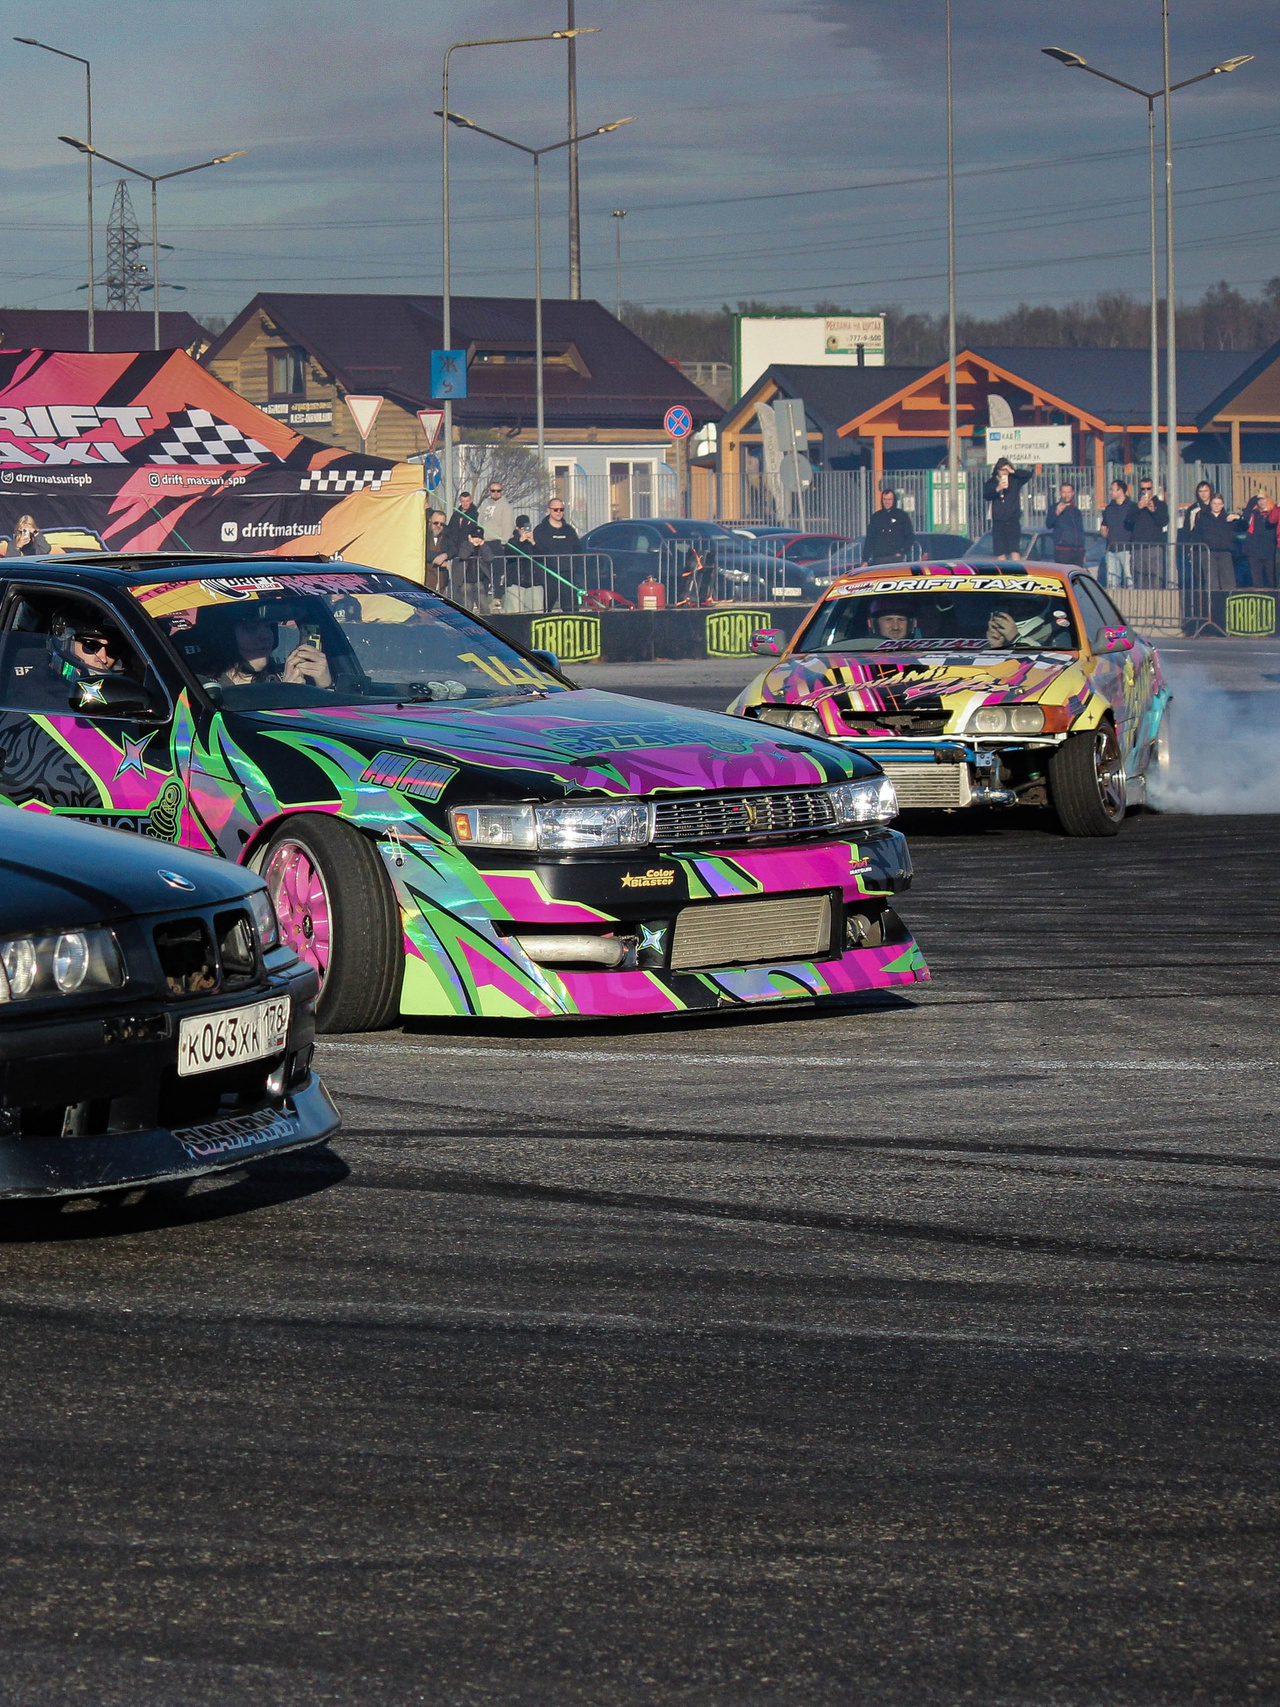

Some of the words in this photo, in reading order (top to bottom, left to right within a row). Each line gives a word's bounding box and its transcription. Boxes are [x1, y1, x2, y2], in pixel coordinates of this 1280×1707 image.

[241, 521, 322, 538] driftmatsuri
[225, 576, 275, 588] DRIFT
[875, 578, 965, 592] DRIFT
[970, 578, 1036, 591] TAXI
[1229, 598, 1272, 632] TRIALLI
[535, 620, 597, 656] TRIALLI
[646, 868, 675, 877] Color
[630, 878, 674, 888] Blaster
[262, 1002, 286, 1038] 178
